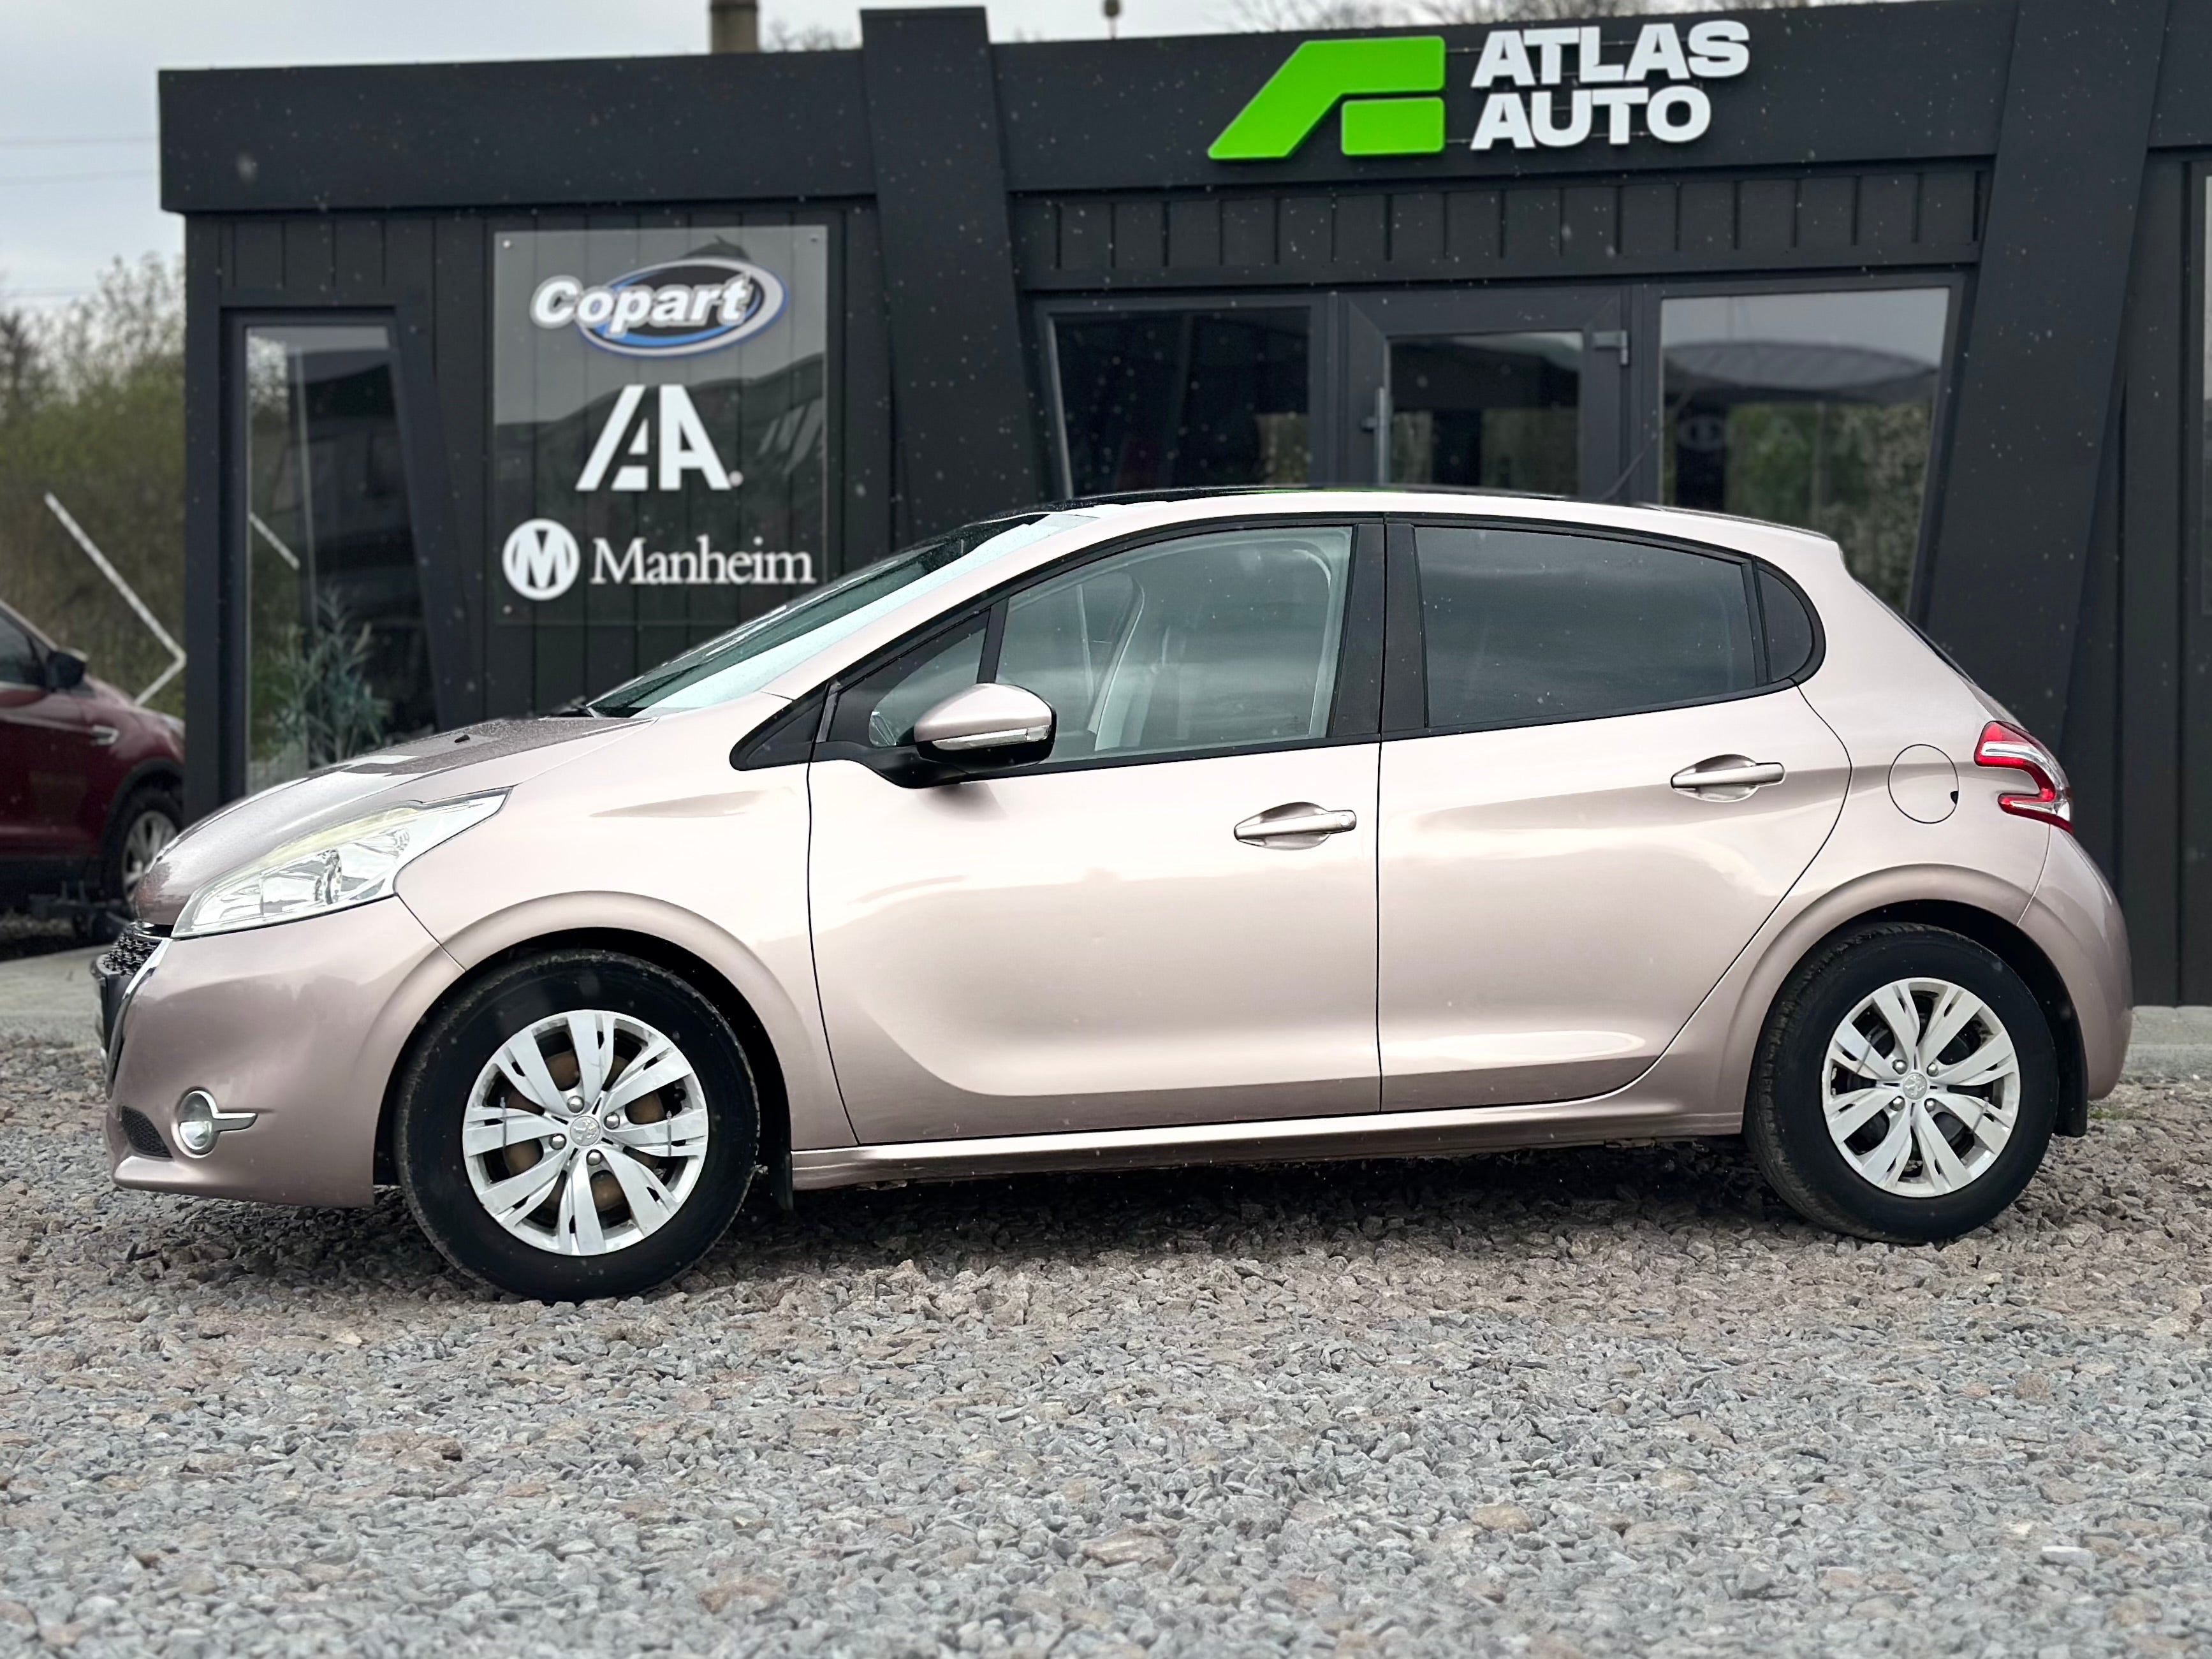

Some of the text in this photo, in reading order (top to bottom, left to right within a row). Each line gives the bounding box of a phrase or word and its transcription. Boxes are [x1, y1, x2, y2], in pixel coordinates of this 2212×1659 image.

[1470, 20, 1750, 88] ATLAS
[1470, 86, 1711, 150] AUTO
[532, 272, 752, 337] Copart
[590, 534, 817, 585] Manheim
